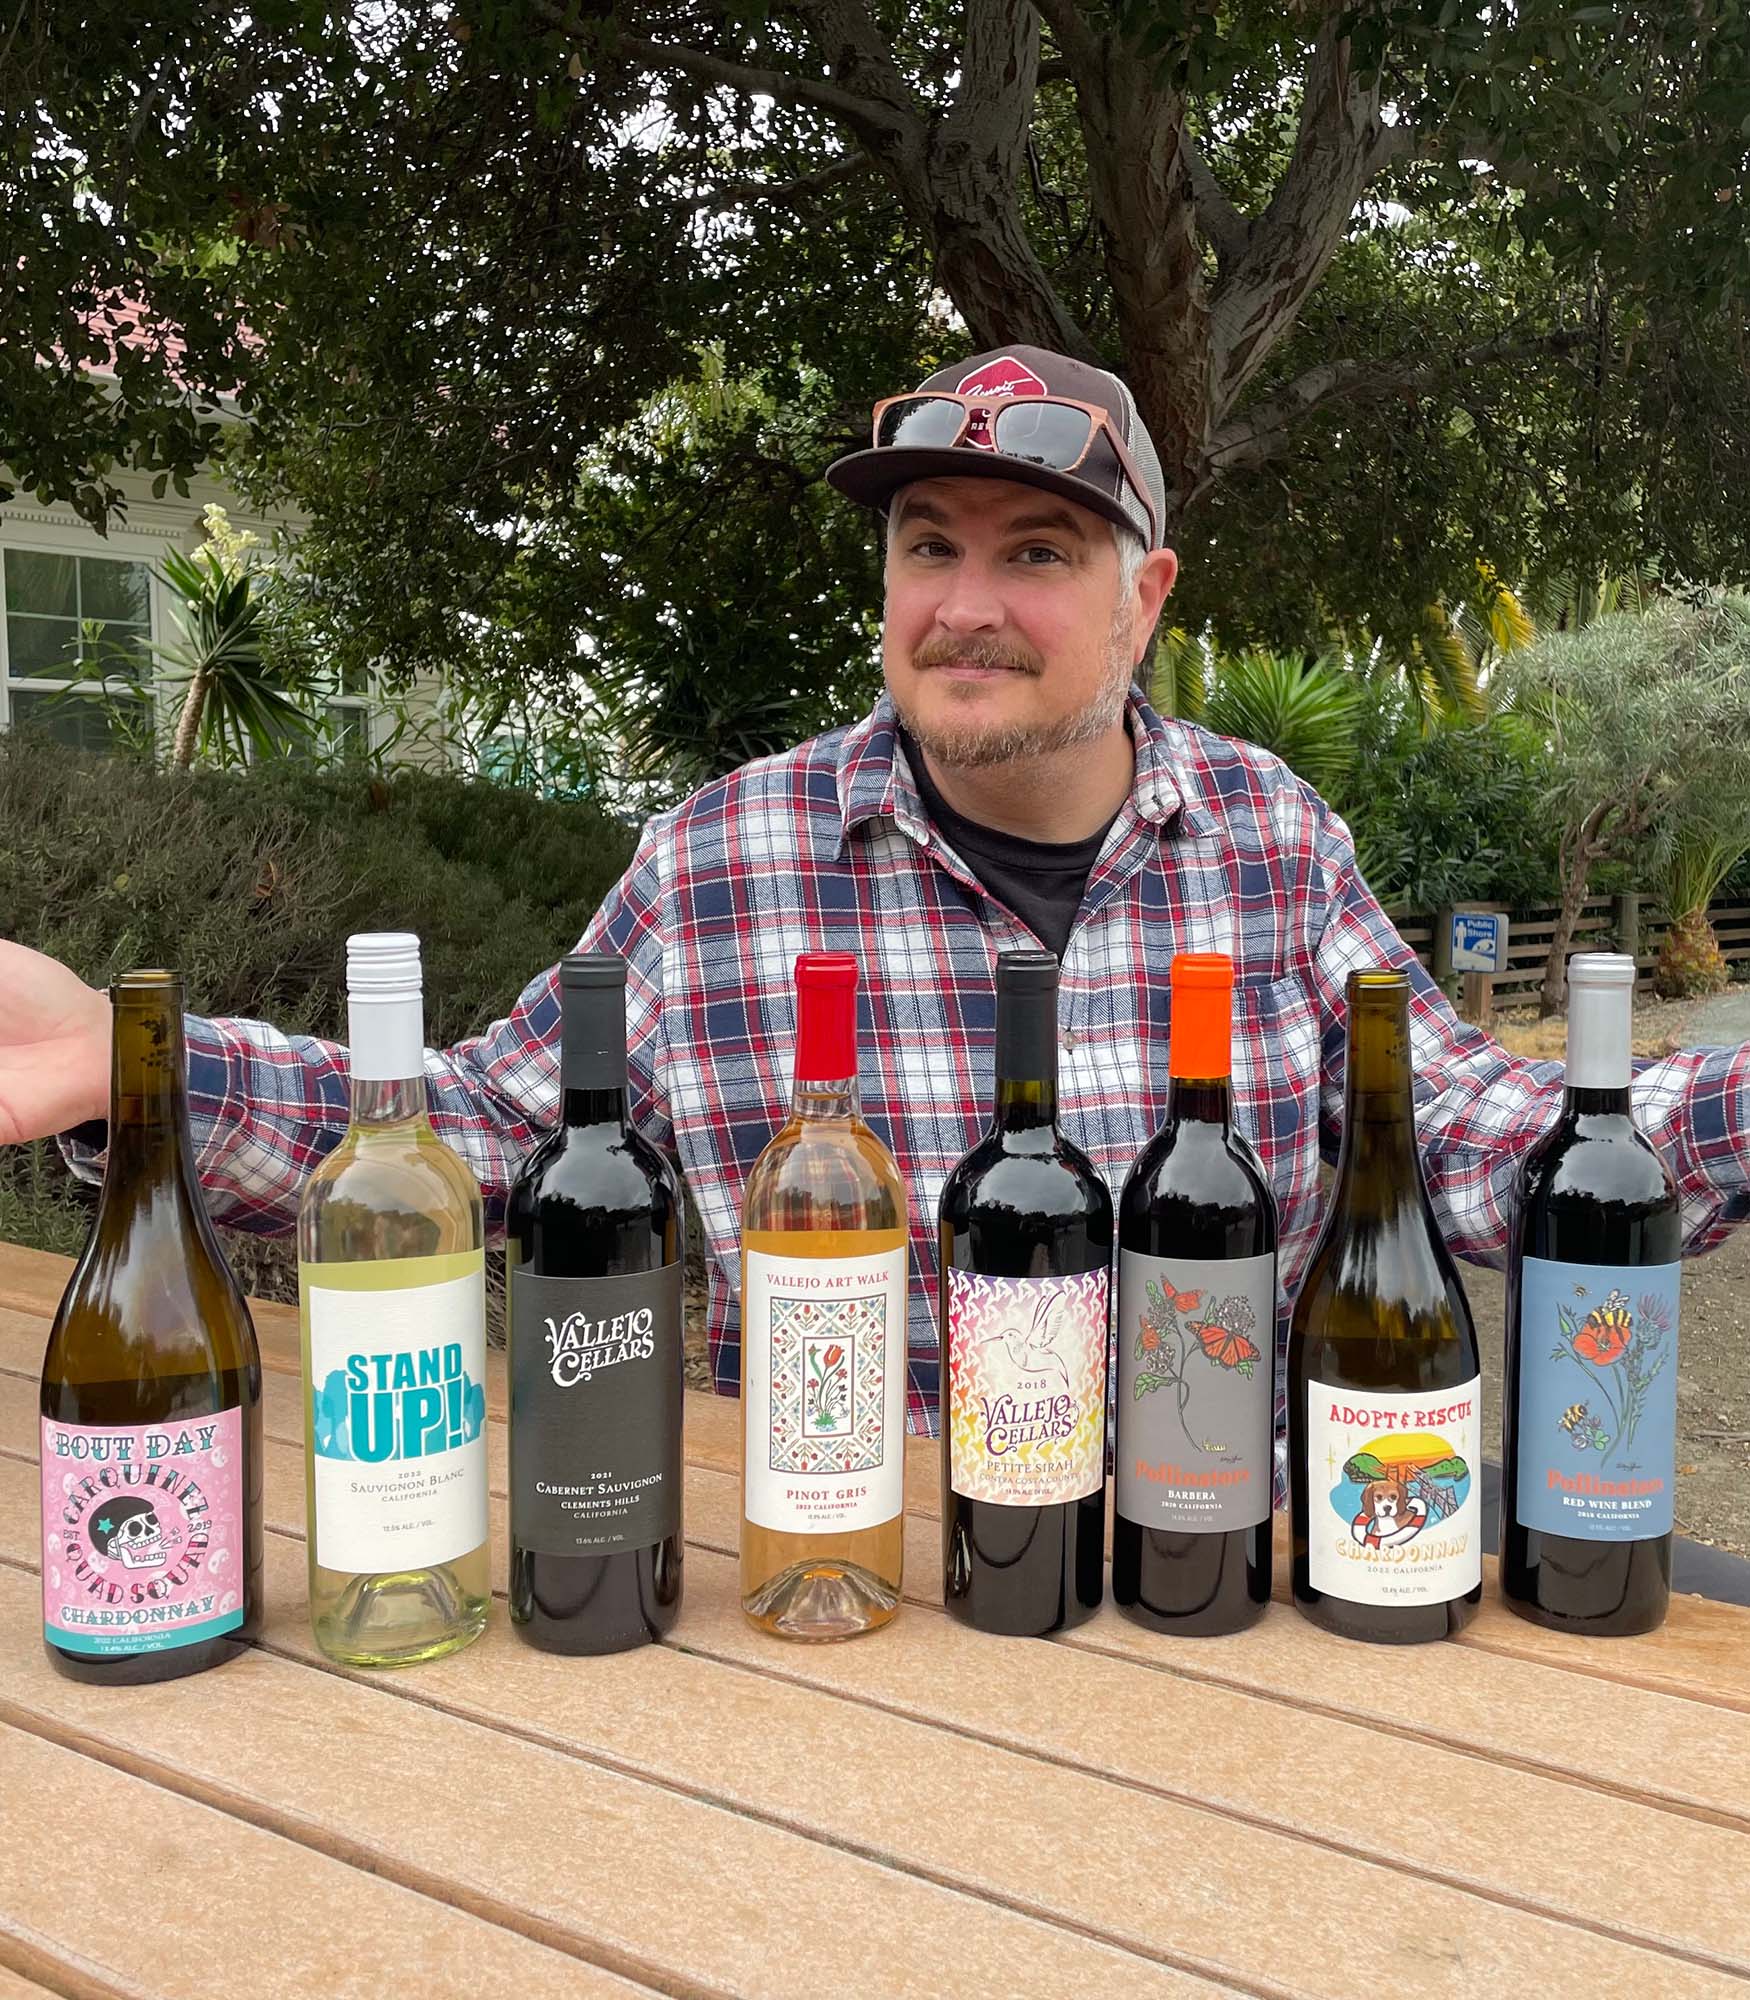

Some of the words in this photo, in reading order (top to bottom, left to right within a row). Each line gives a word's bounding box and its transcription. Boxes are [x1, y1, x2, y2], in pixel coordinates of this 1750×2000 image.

[1467, 920, 1493, 929] Public
[1467, 929, 1493, 937] Shore
[766, 1273, 821, 1290] VALLEJO
[825, 1277, 853, 1288] ART
[857, 1271, 889, 1286] WALK
[544, 1307, 653, 1364] VALLEJO
[551, 1330, 654, 1388] CELLARS
[347, 1343, 463, 1391] STAND
[1016, 1378, 1047, 1390] 2018
[350, 1378, 463, 1463] UP!
[980, 1394, 1071, 1435] VALLEJO
[1329, 1404, 1398, 1429] ADOPT
[1414, 1400, 1472, 1427] RESCUE
[986, 1414, 1072, 1456] CELLARS
[55, 1432, 135, 1461] BOUT
[146, 1425, 217, 1459] DAY
[987, 1460, 1032, 1473] PETITE
[1035, 1459, 1073, 1472] SIRAH
[590, 1471, 612, 1480] 2021
[381, 1489, 437, 1502] CALIFORNIA
[786, 1489, 830, 1500] PINOT
[836, 1486, 867, 1499] GRIS
[1168, 1489, 1216, 1500] BARBERA
[560, 1500, 611, 1509] CLEMENTS
[614, 1494, 640, 1506] HILLS
[814, 1502, 857, 1510] CALIFORNIA
[1563, 1496, 1585, 1507] RED
[1589, 1500, 1617, 1510] WINE
[1621, 1499, 1653, 1510] BLEND
[573, 1508, 628, 1519] CALIFORNIA
[1596, 1512, 1640, 1520] CALIFORNIA
[187, 1520, 212, 1533] 2019
[1336, 1534, 1468, 1563] CHARDONNAY
[1393, 1565, 1443, 1575] CALIFORNIA
[61, 1595, 215, 1626] CHARDONNAY
